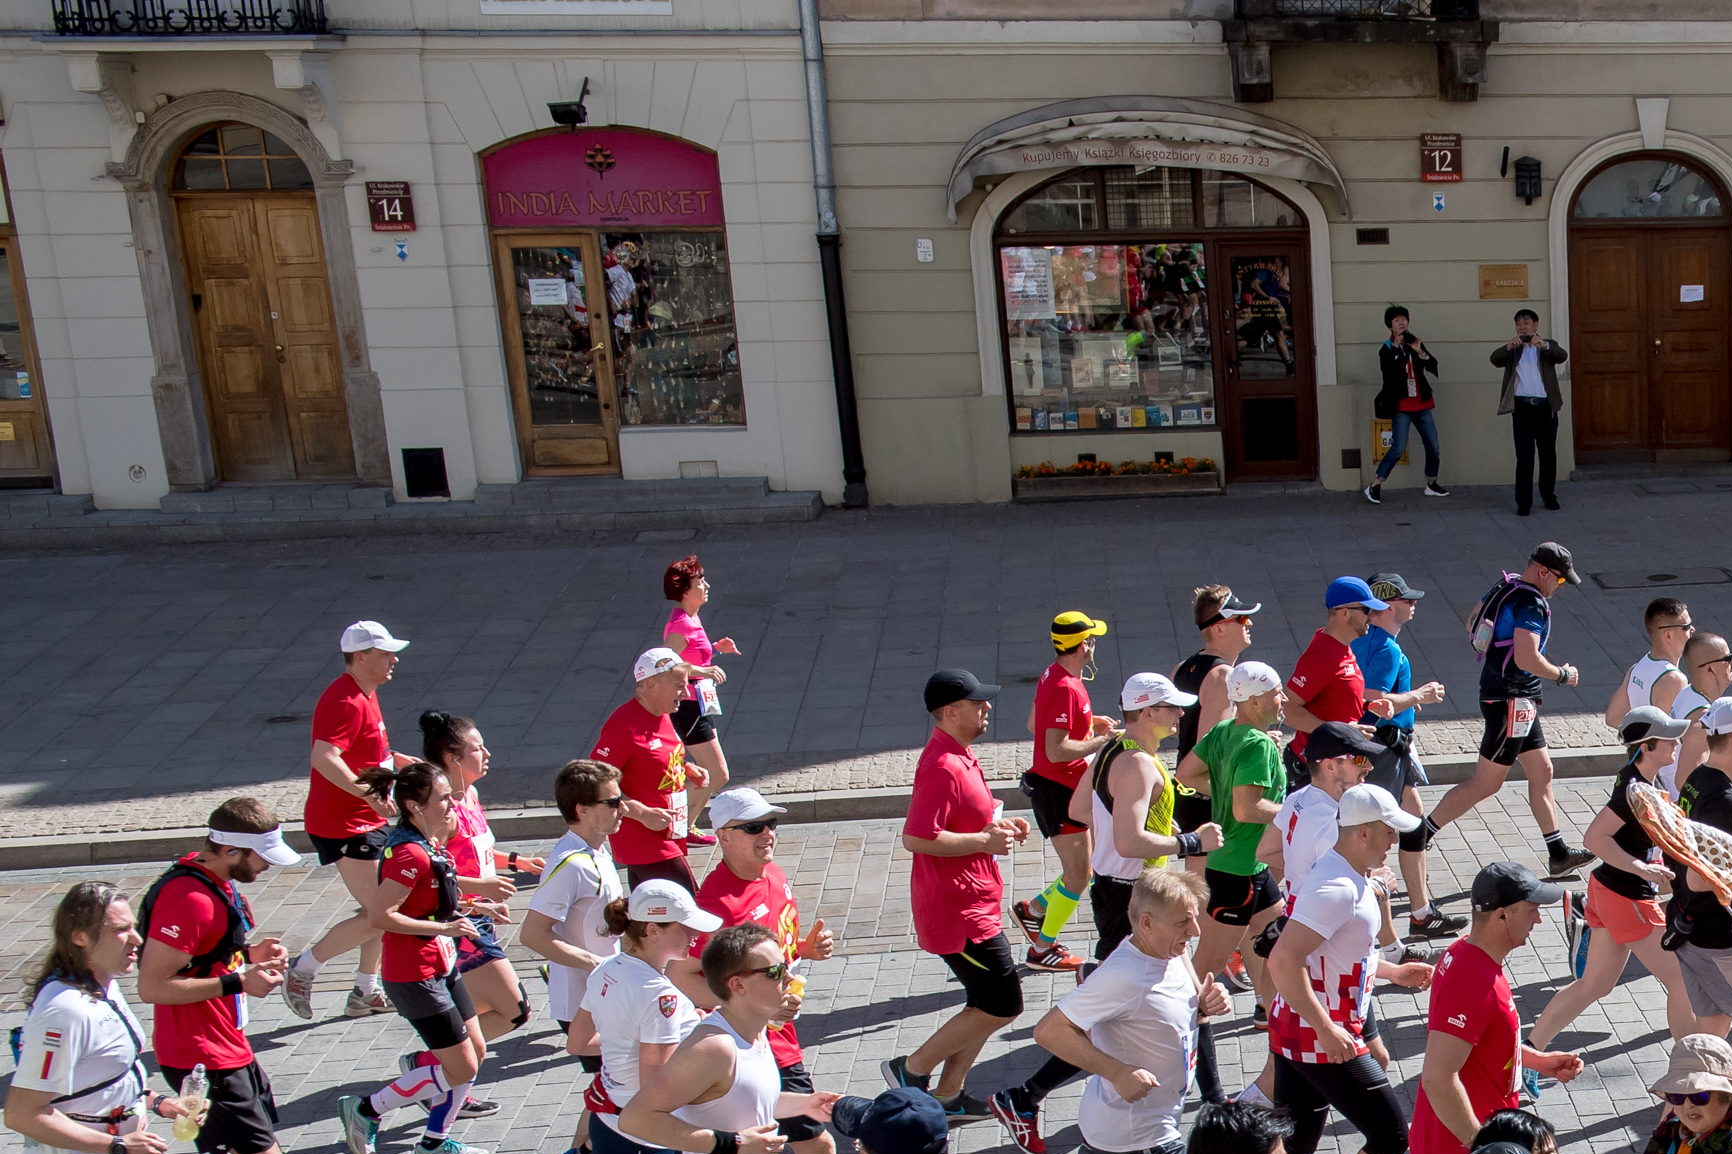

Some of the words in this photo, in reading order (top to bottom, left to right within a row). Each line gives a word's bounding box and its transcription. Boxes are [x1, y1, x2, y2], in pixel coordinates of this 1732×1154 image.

[1022, 149, 1080, 163] Kupujemy
[1085, 147, 1125, 161] Książki
[1128, 147, 1201, 163] Księgozbiory
[1219, 154, 1239, 164] 826
[1242, 155, 1254, 165] 73
[1257, 156, 1270, 167] 23
[1431, 150, 1452, 172] 12
[378, 198, 403, 221] 14
[496, 191, 580, 216] INDIA
[587, 189, 713, 216] MARKET
[1382, 438, 1393, 446] GA
[1447, 1017, 1465, 1028] ORLEN
